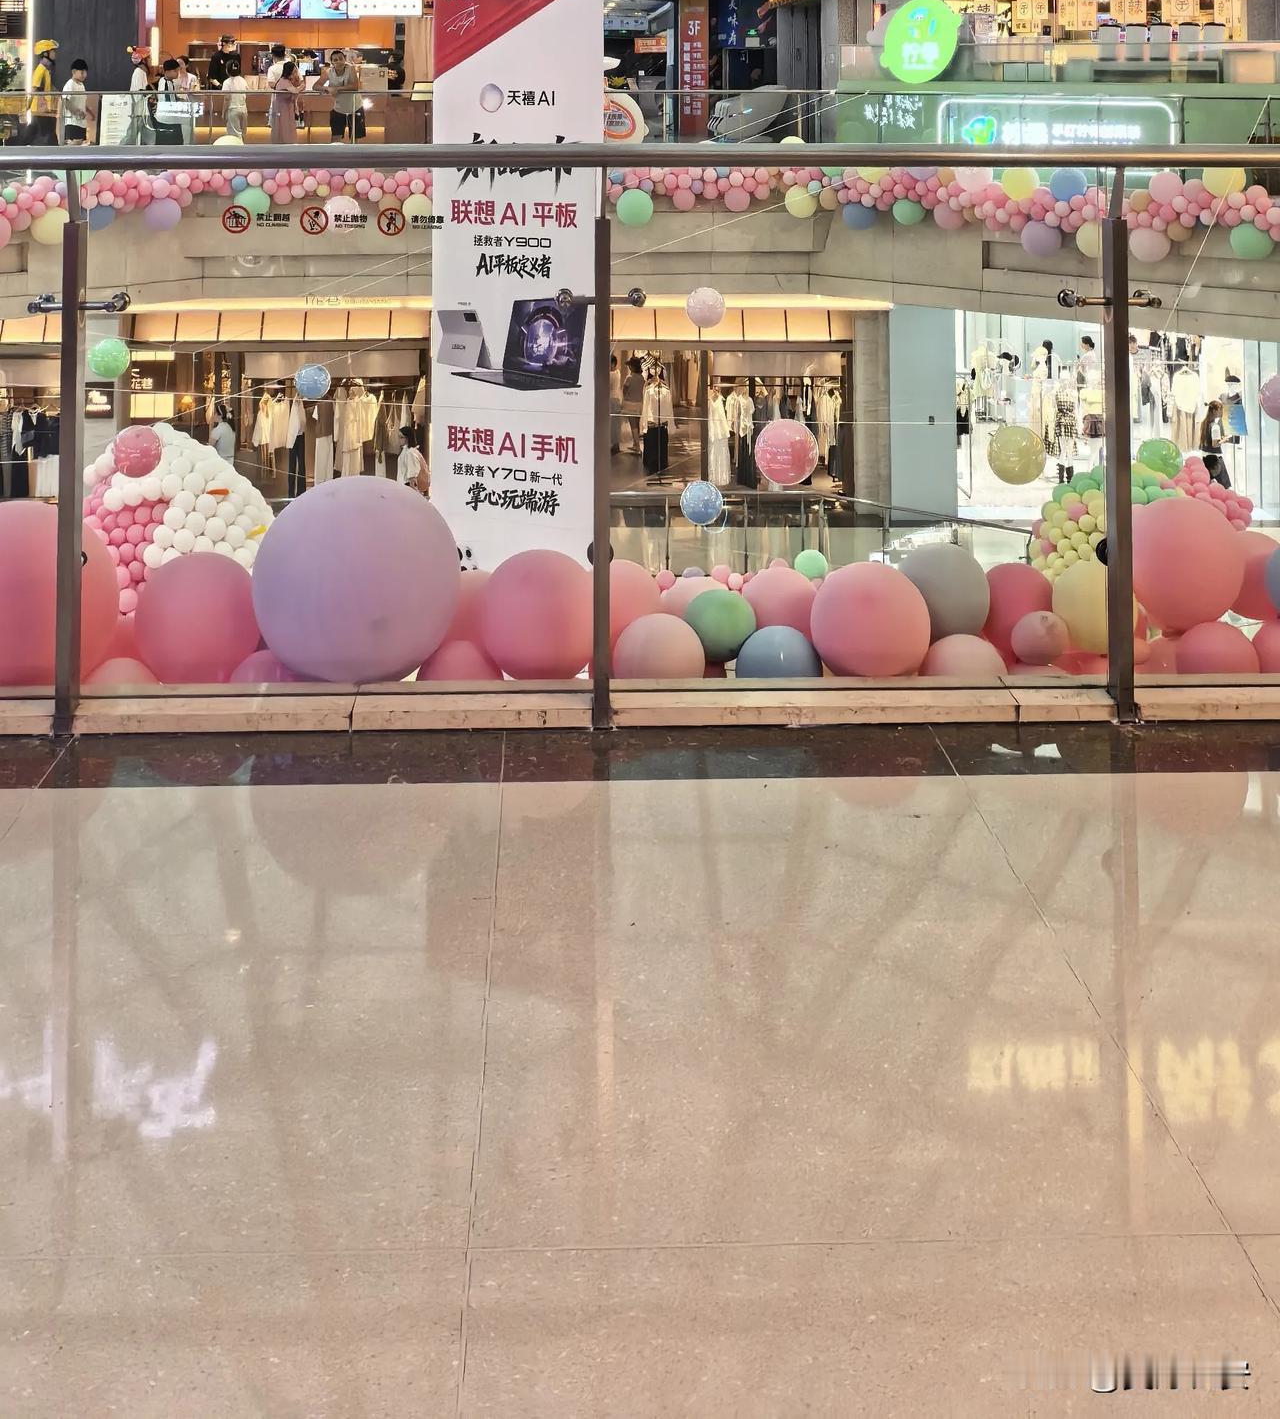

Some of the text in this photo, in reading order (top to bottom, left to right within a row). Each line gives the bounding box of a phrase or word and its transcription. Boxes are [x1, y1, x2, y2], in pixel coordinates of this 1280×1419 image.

[687, 20, 702, 36] 3F
[507, 90, 556, 107] 天禧AI
[333, 213, 368, 223] 禁止抛物
[473, 234, 552, 249] 拯救者Y900
[475, 252, 552, 279] AI平板定义者
[465, 481, 561, 517] 掌心玩端游
